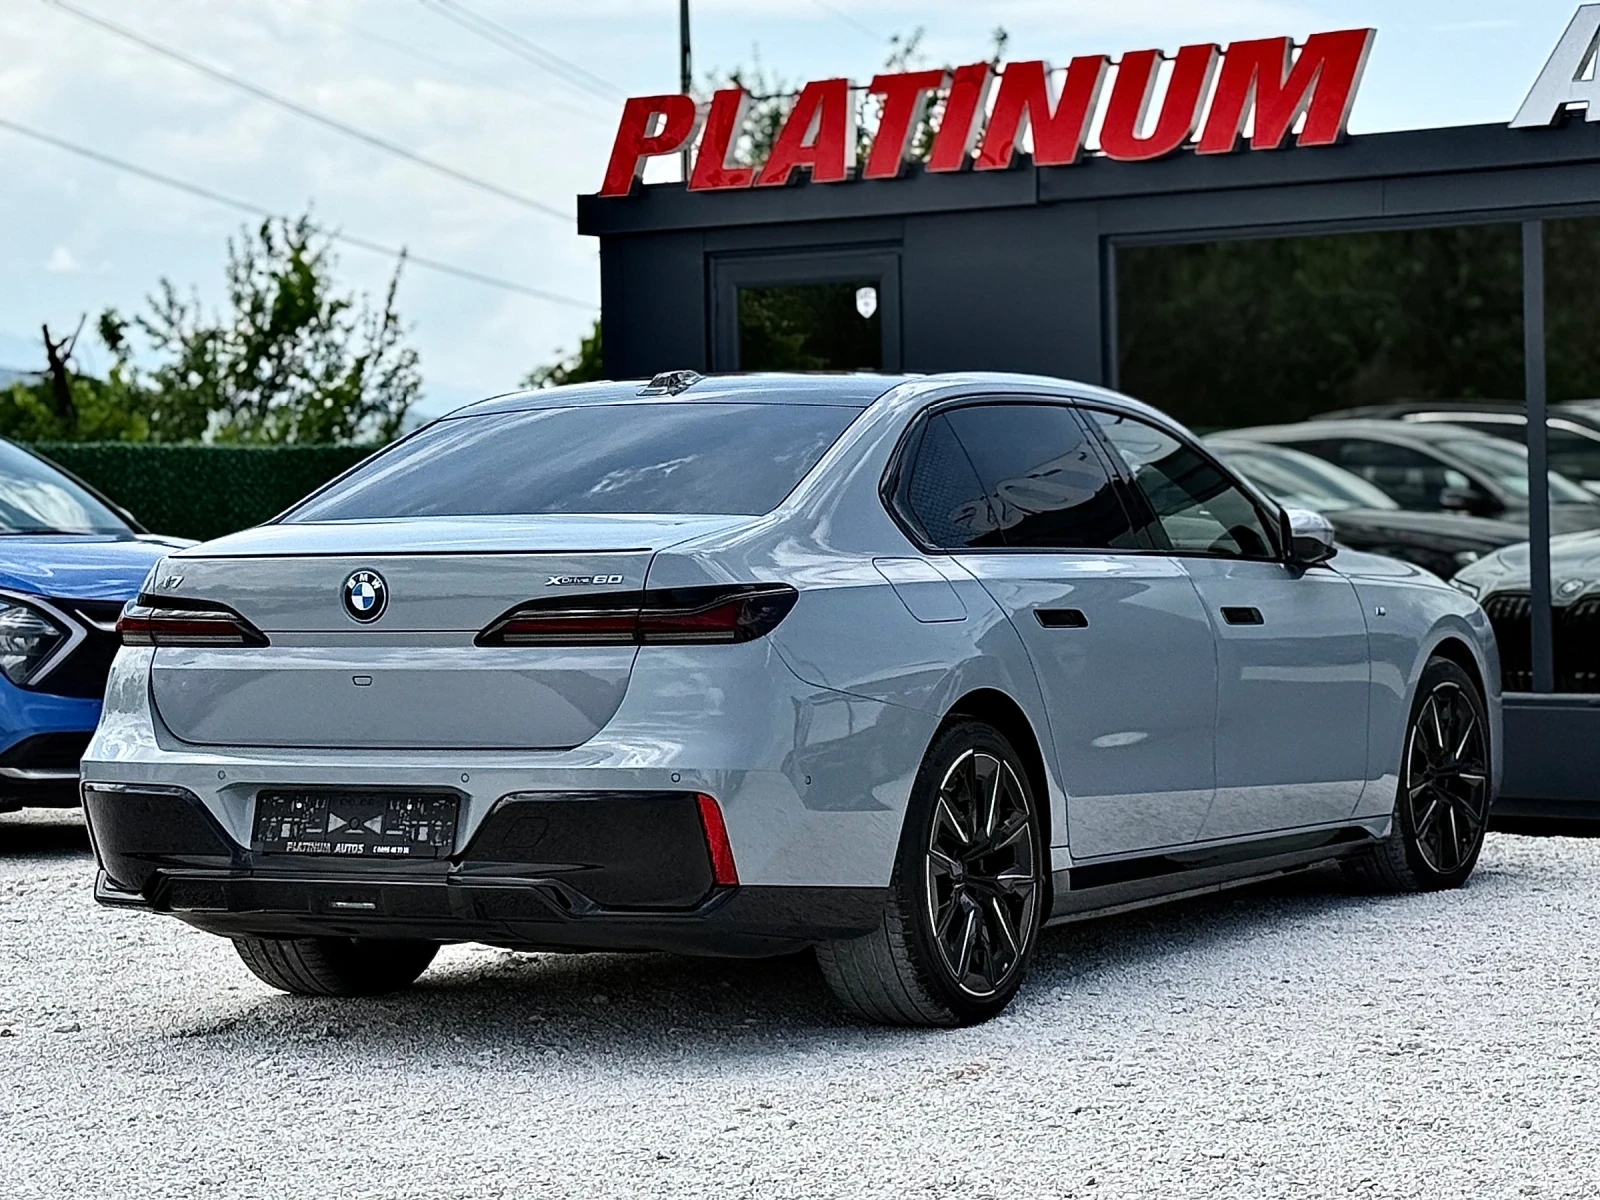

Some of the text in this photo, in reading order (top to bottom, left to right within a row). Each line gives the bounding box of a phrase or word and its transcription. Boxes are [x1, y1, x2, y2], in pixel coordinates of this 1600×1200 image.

[598, 28, 1377, 197] PLATINUM
[347, 573, 382, 590] BMW
[285, 841, 331, 853] PLATINUM
[333, 842, 365, 854] AUTOS
